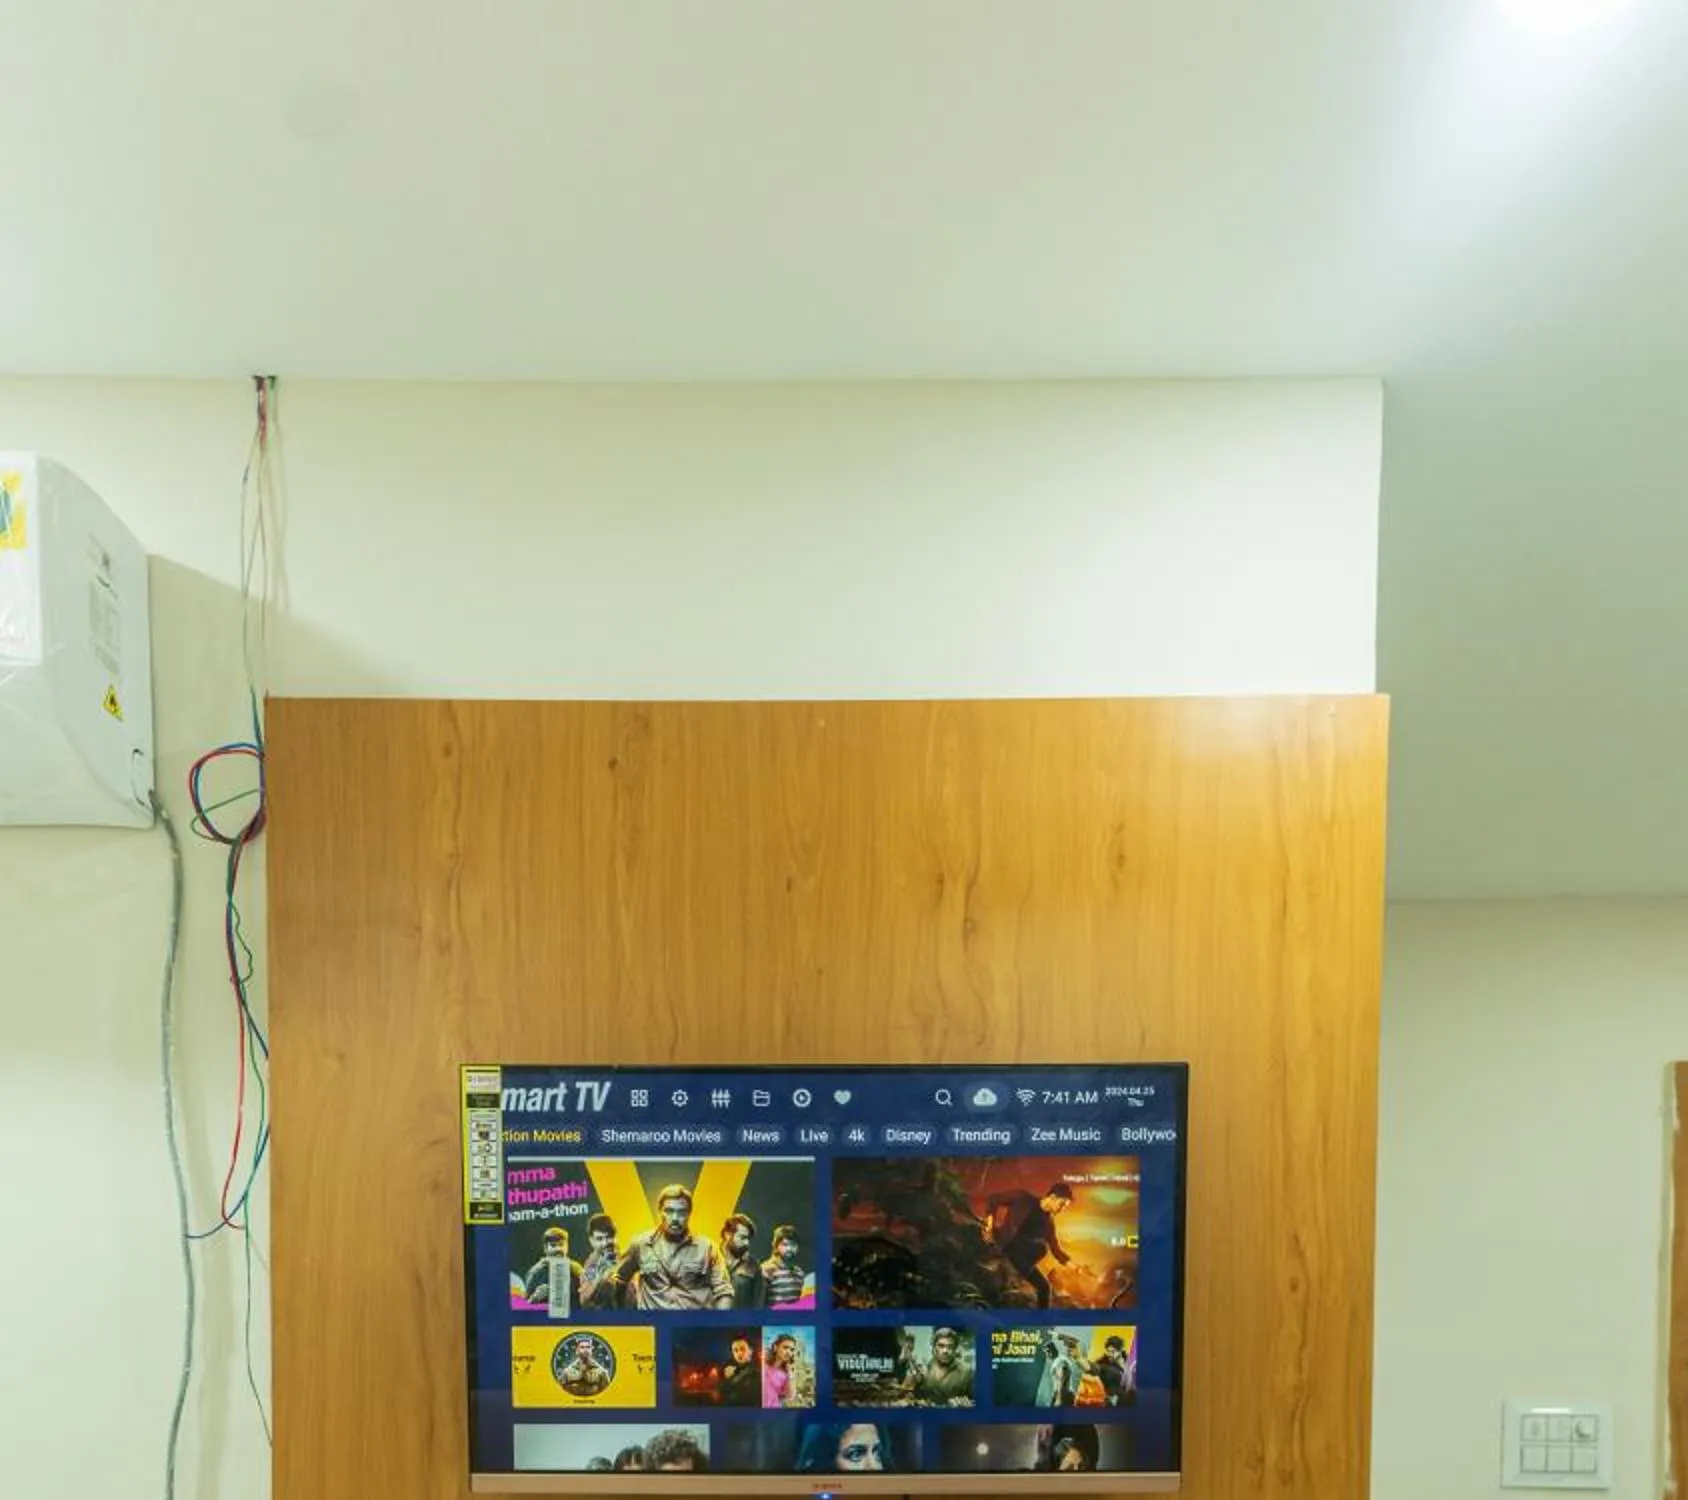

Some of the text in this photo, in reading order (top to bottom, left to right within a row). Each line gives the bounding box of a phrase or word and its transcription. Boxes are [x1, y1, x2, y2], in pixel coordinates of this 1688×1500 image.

[575, 1081, 612, 1112] TV
[1041, 1091, 1098, 1104] 7:41 AM
[533, 1129, 582, 1143] Movies
[601, 1129, 721, 1143] Shemaroo Movies
[743, 1129, 780, 1142] News
[801, 1129, 829, 1142] Live
[885, 1129, 931, 1145] Disney
[953, 1128, 1011, 1145] Trending
[1031, 1127, 1101, 1141] Zee Music
[1121, 1127, 1176, 1144] Bollywo
